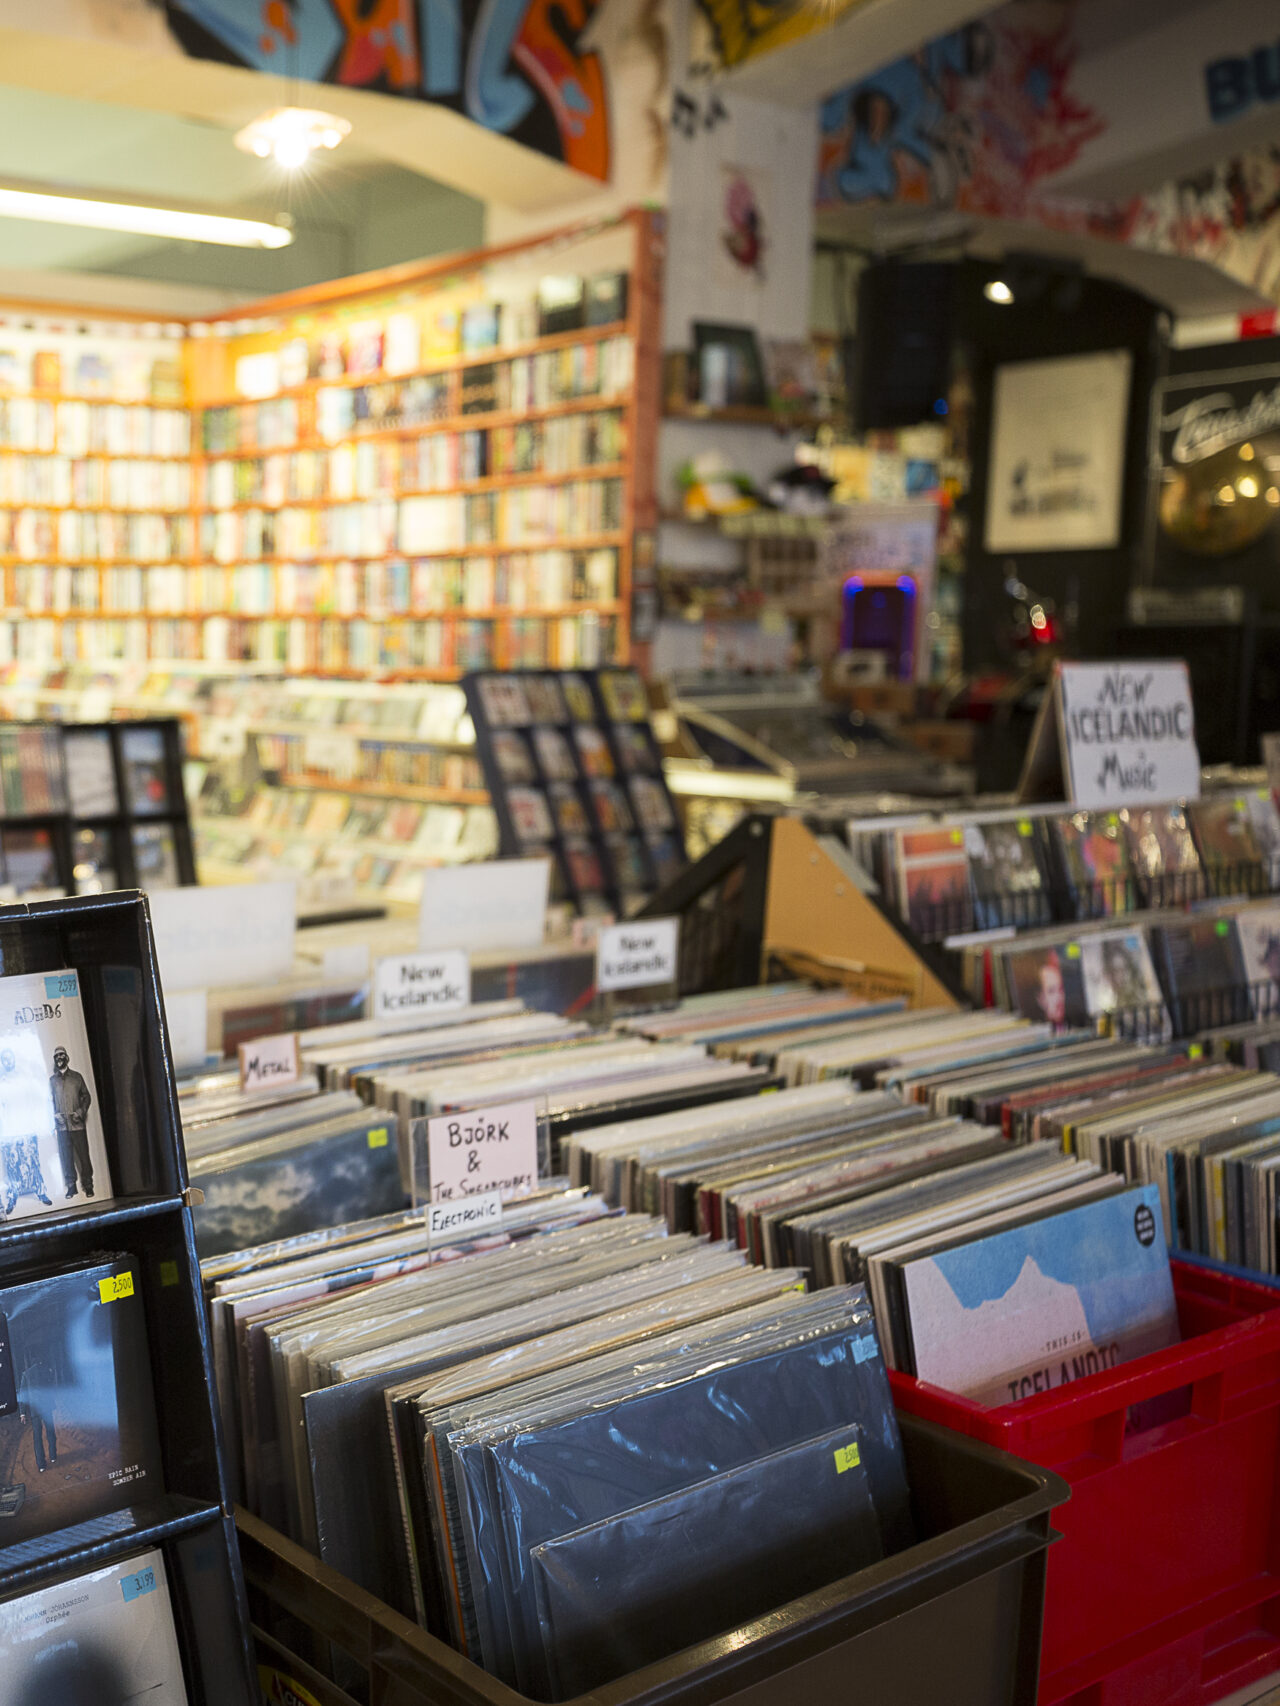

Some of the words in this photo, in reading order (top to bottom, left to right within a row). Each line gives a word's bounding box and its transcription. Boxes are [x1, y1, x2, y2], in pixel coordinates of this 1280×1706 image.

[1070, 702, 1187, 744] ICELANDIC
[620, 936, 655, 952] New
[400, 965, 444, 982] New
[383, 983, 461, 1010] Icelandic
[447, 1117, 509, 1148] BJÖRK
[467, 1150, 481, 1173] &
